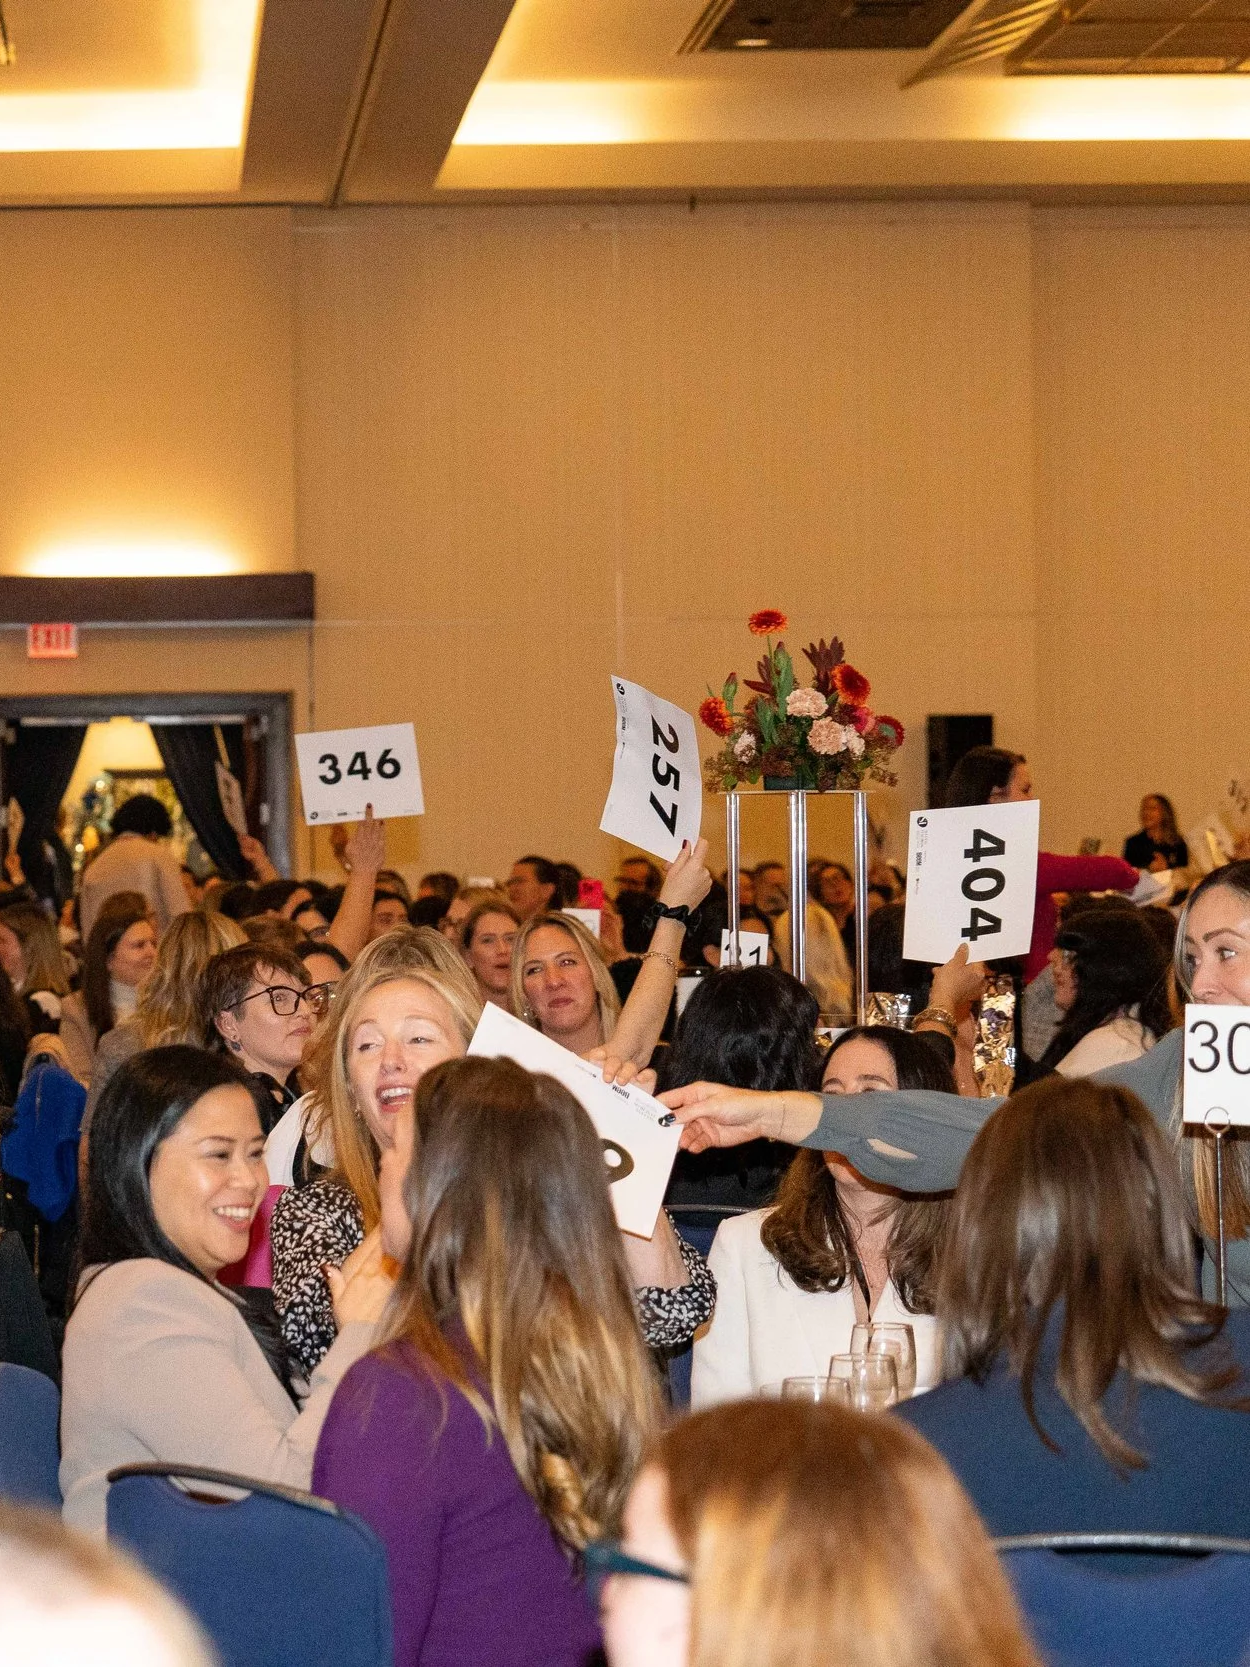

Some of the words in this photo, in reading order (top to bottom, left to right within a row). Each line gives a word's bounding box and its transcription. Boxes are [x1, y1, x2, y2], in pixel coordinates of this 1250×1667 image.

[318, 748, 401, 785] 346
[649, 714, 680, 837] 257
[961, 828, 1006, 942] 404
[1188, 1020, 1250, 1075] 30
